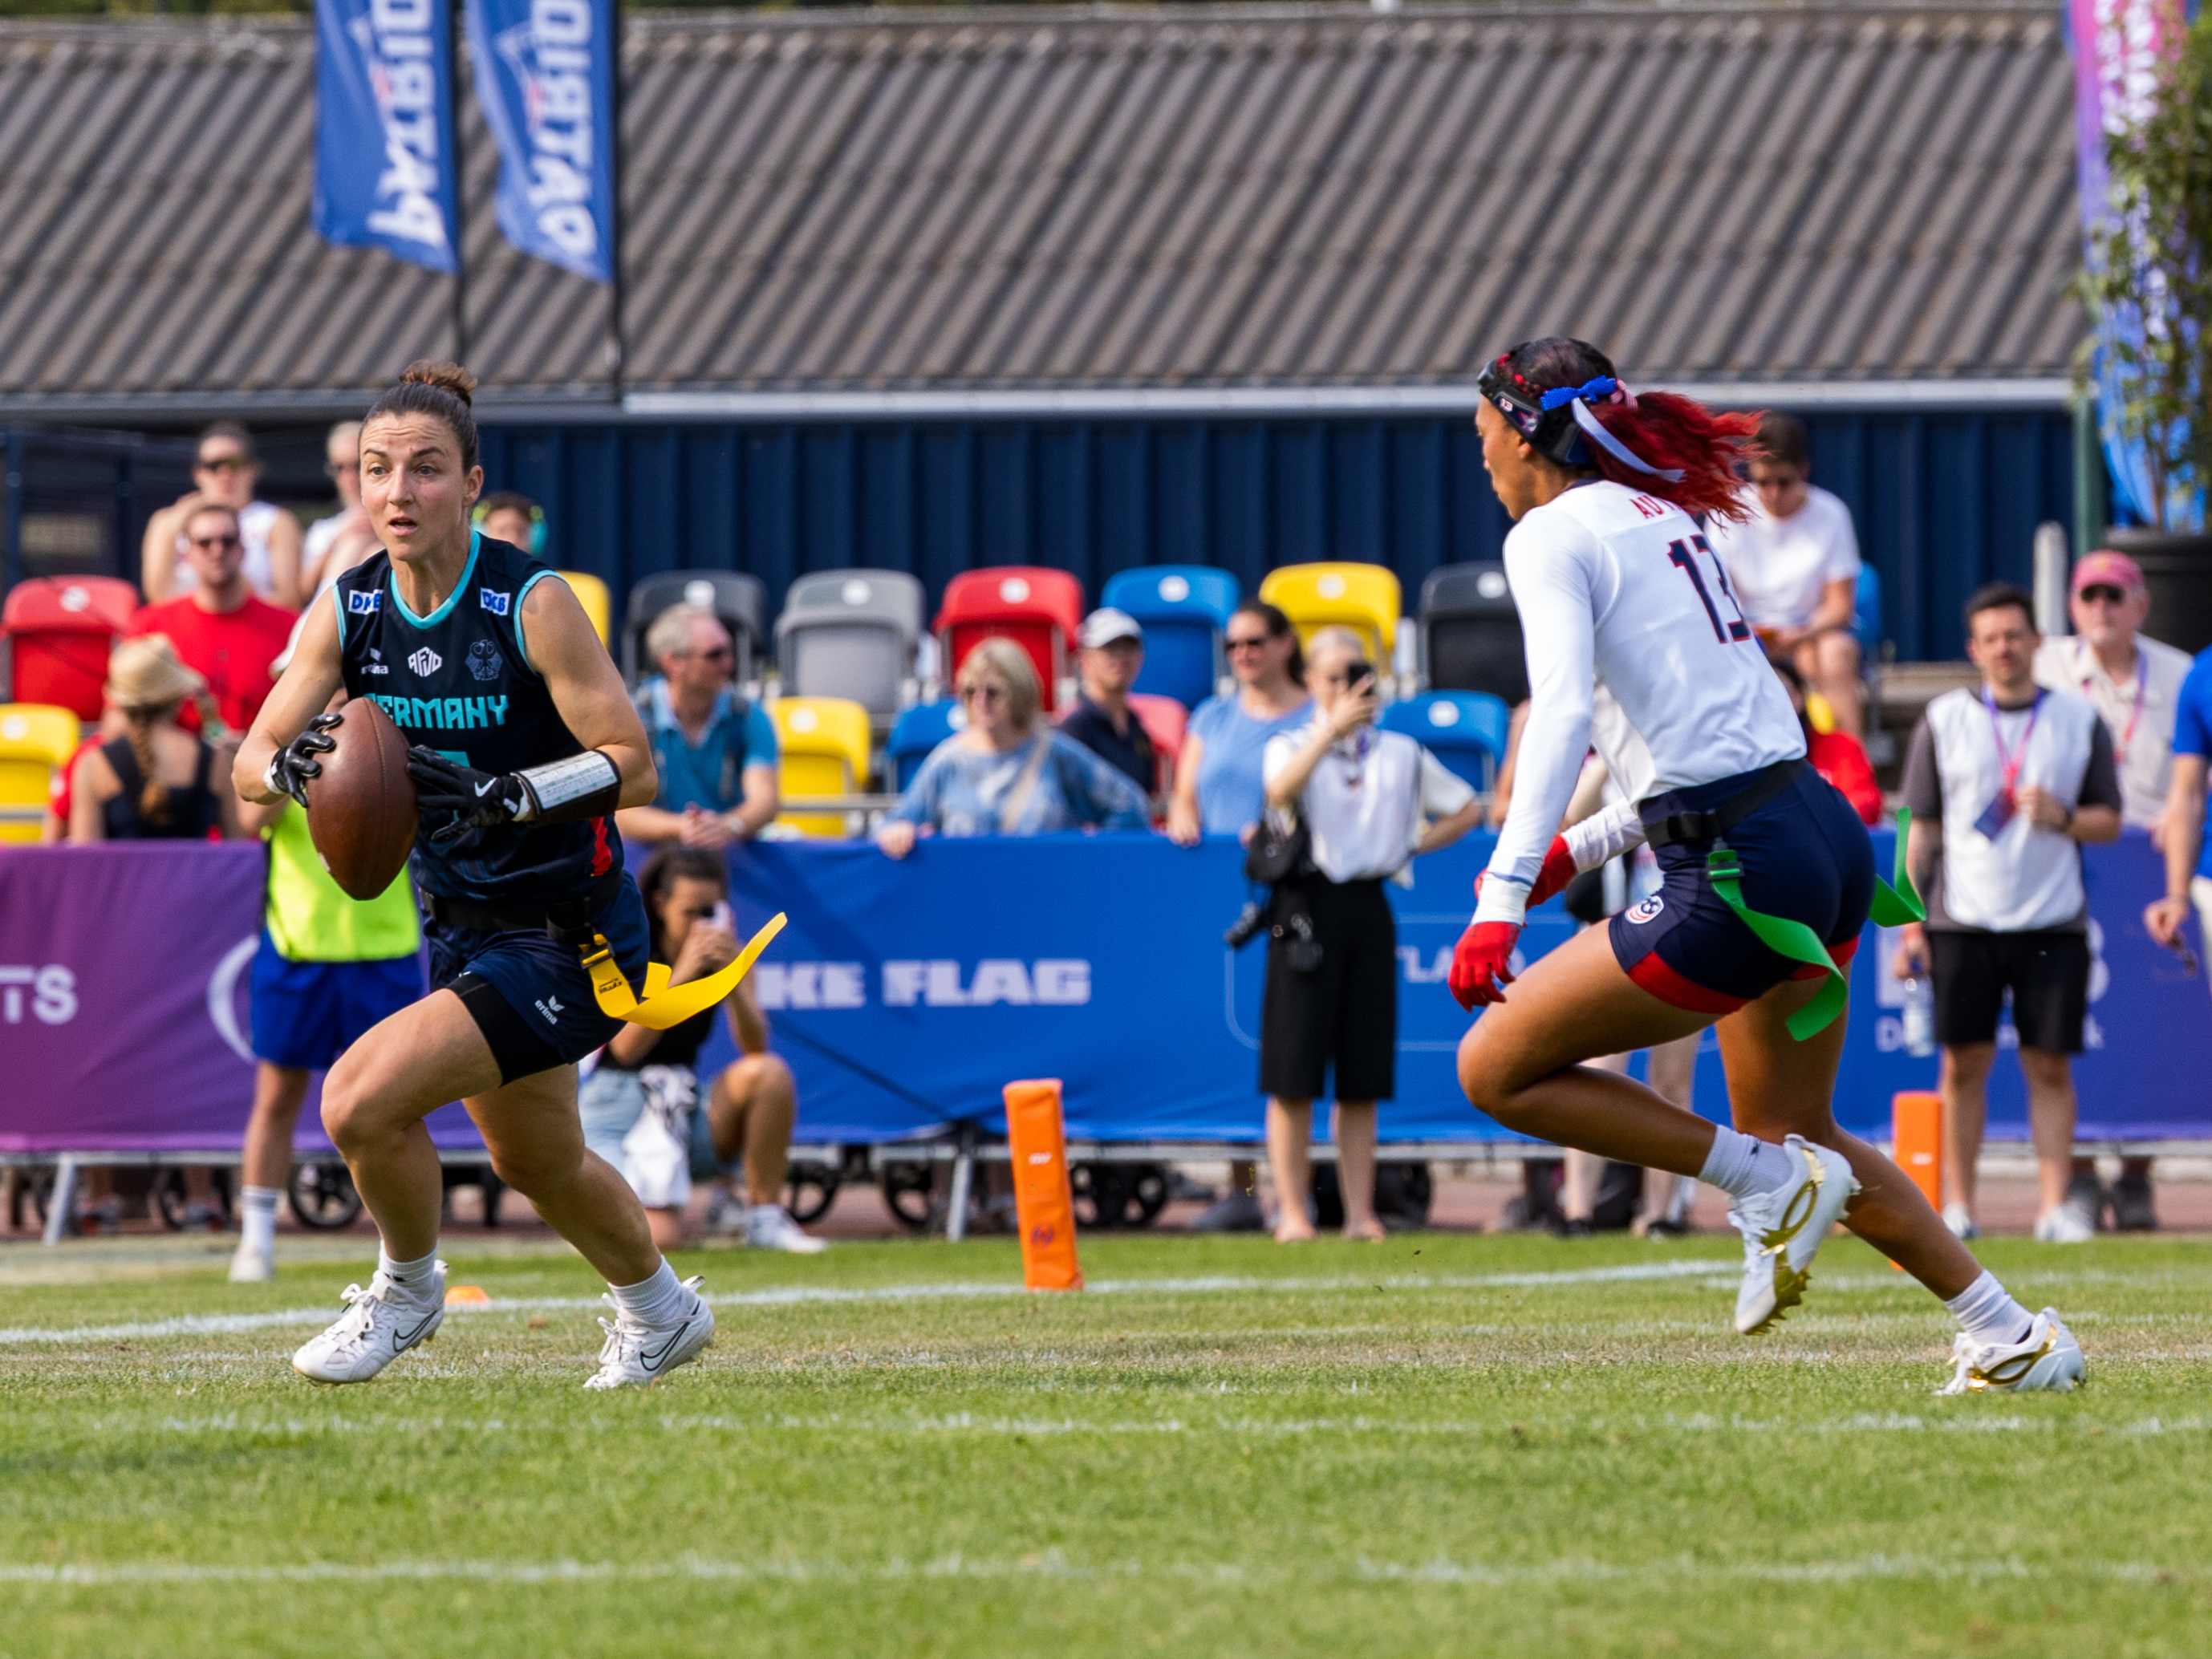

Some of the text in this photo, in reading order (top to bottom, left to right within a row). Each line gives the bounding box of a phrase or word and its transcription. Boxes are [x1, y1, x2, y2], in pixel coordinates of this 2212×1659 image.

[1500, 398, 1513, 412] 13
[482, 592, 505, 612] DKB
[363, 693, 509, 729] ERMANY
[883, 959, 1092, 1007] FLAG
[534, 1000, 558, 1025] erima
